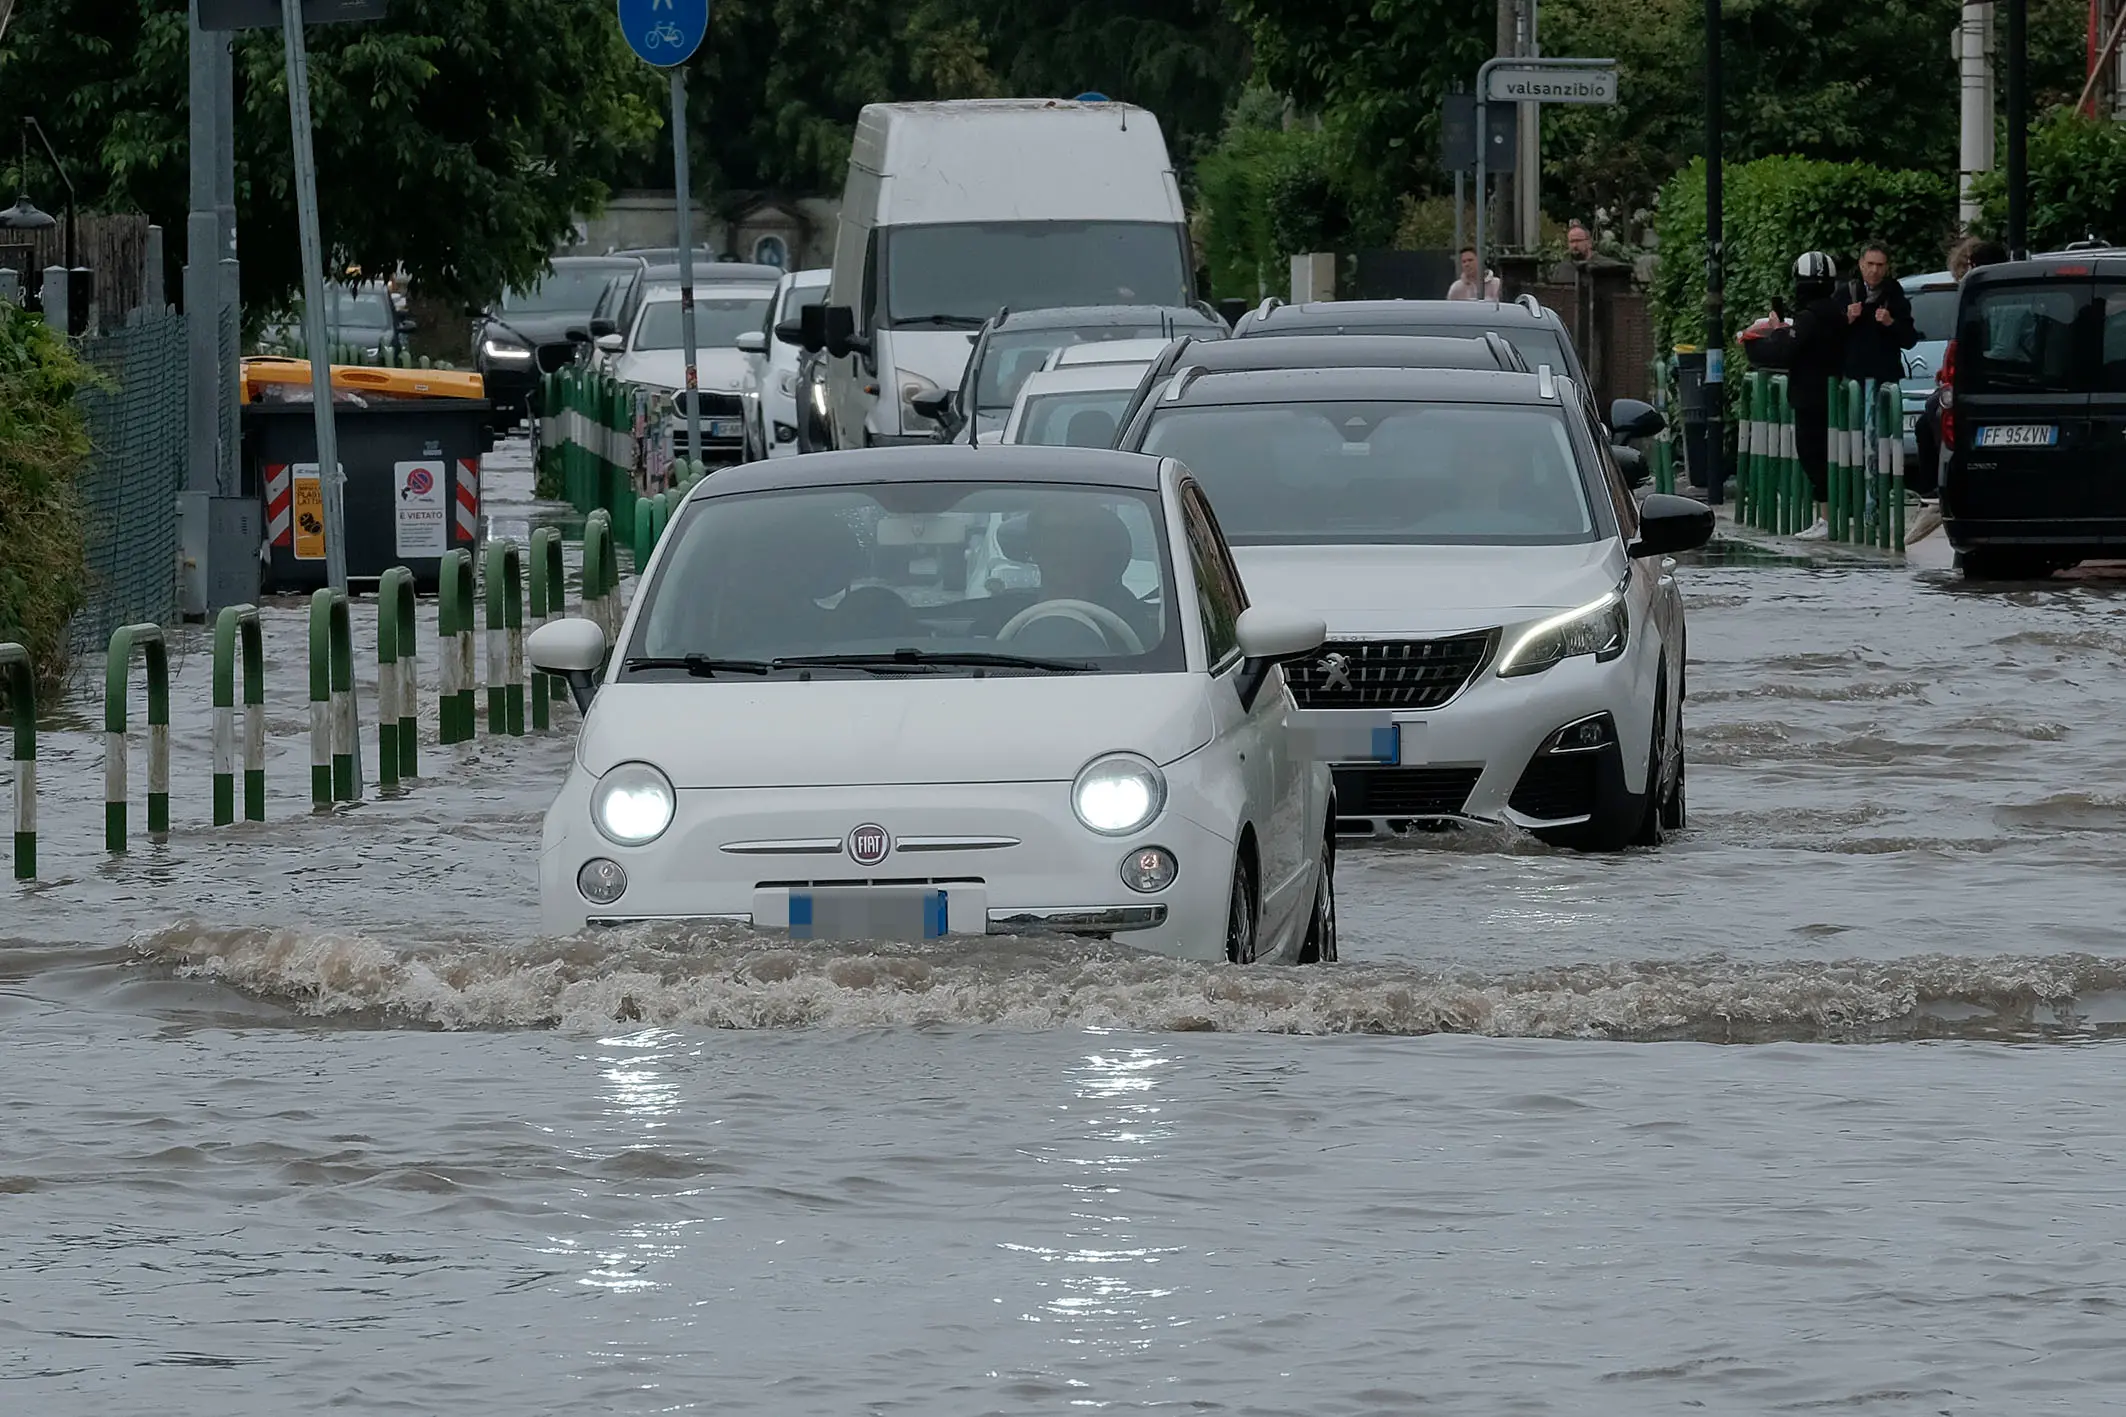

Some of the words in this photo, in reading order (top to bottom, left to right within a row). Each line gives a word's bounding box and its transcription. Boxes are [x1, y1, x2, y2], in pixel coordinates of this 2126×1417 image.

[1507, 81, 1605, 96] valsanzibio
[1984, 428, 2001, 443] FF
[2006, 426, 2049, 443] 954VN
[407, 511, 443, 520] VIETATO
[858, 835, 881, 853] FIAT
